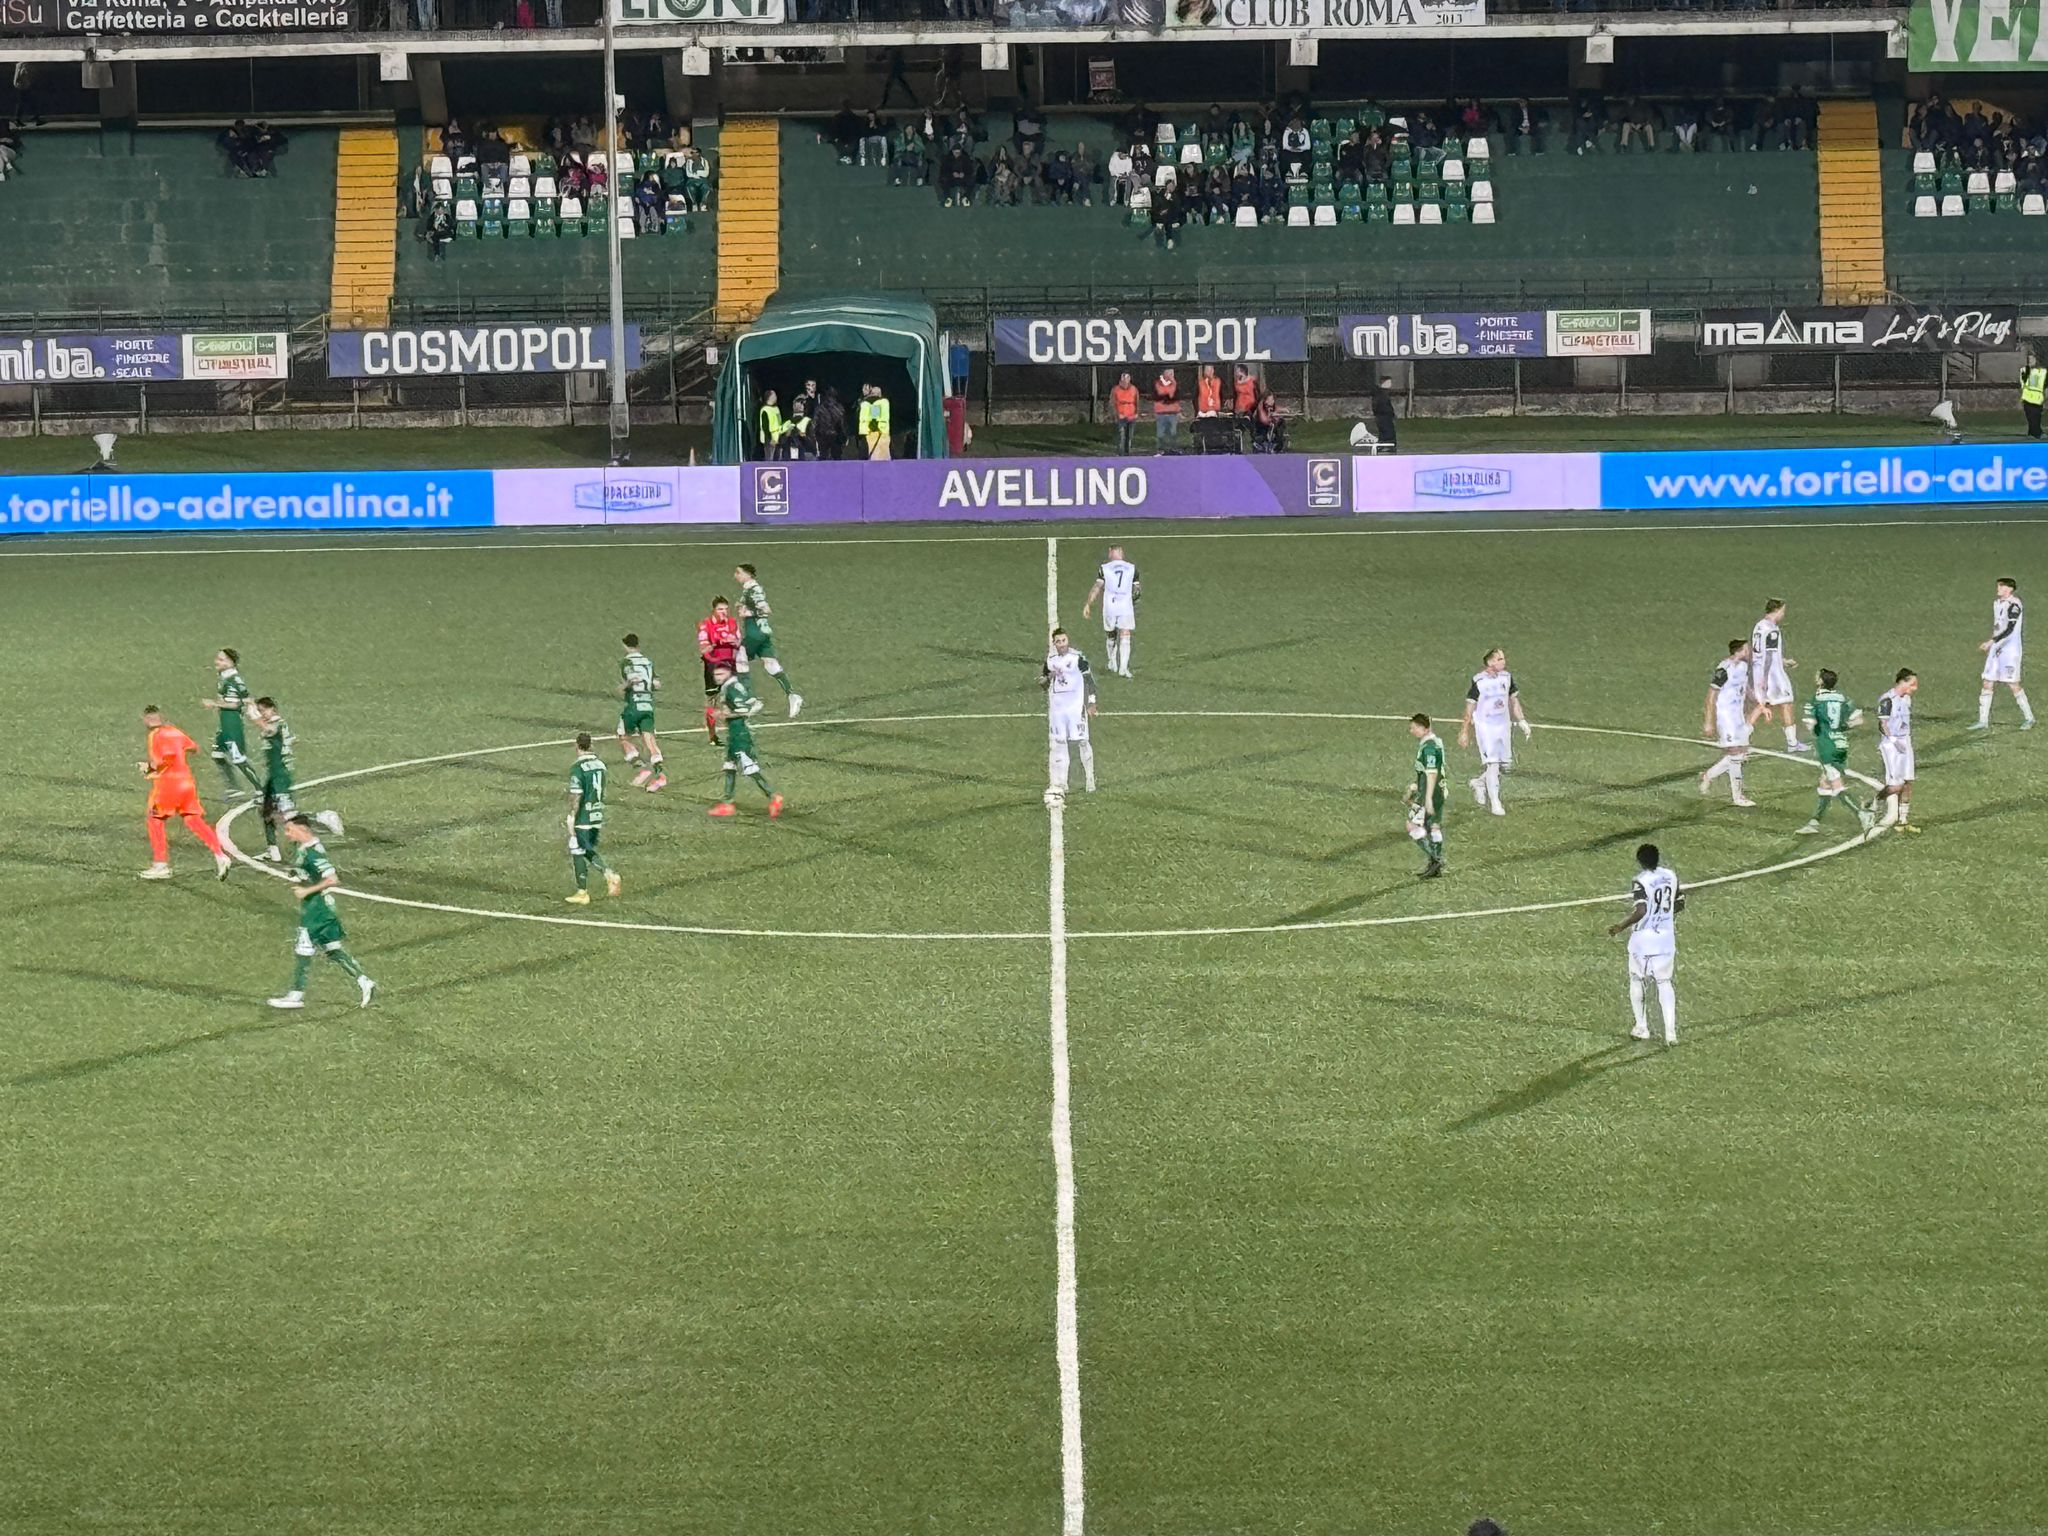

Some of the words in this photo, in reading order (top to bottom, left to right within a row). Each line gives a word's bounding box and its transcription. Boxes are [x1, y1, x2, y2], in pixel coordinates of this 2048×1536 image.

[66, 9, 186, 30] Caffetteria
[194, 14, 208, 28] e
[215, 7, 349, 28] Cocktelleria
[1225, 0, 1310, 26] CLUB
[1324, 0, 1417, 26] ROMA
[363, 326, 607, 375] COSMOPOL
[1028, 317, 1271, 363] COSMOPOL
[938, 467, 1148, 507] AVELLINO
[1115, 570, 1124, 588] 7
[1654, 885, 1672, 914] 93
